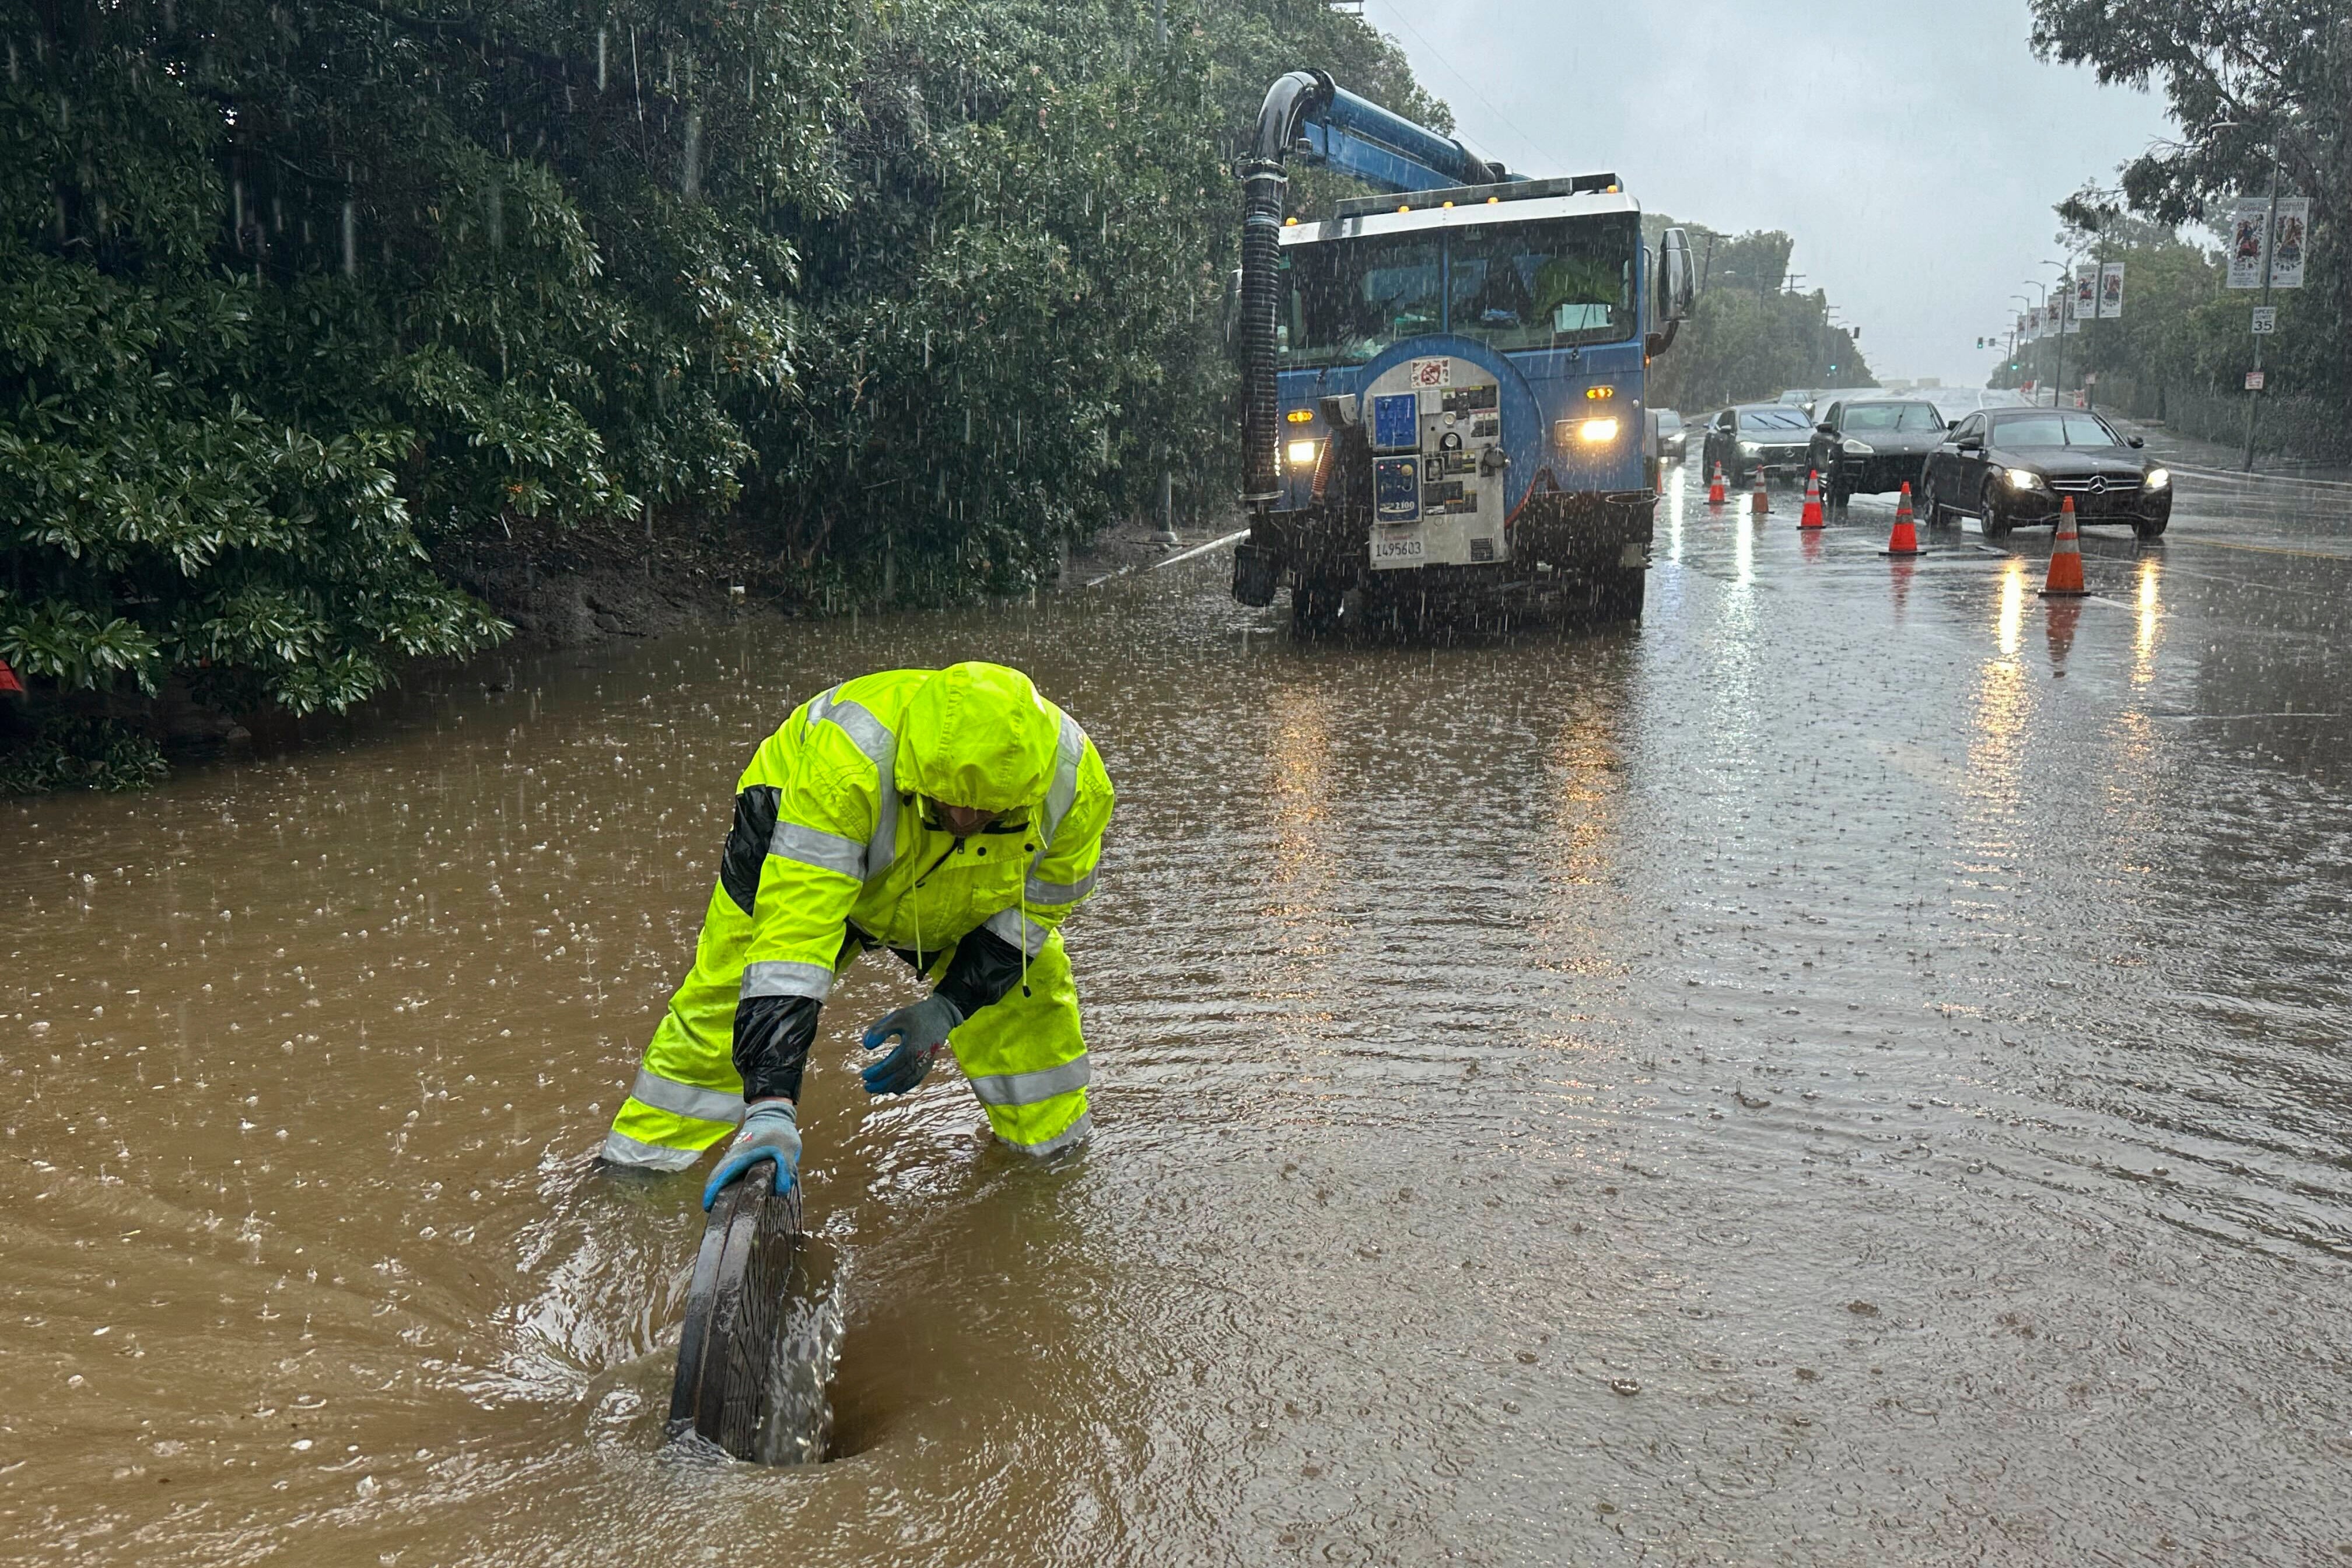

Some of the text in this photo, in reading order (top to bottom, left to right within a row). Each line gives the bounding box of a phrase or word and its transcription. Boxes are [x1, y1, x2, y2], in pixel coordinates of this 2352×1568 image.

[2253, 321, 2273, 331] 35
[1394, 501, 1416, 510] 2100
[1376, 541, 1422, 557] 1495603
